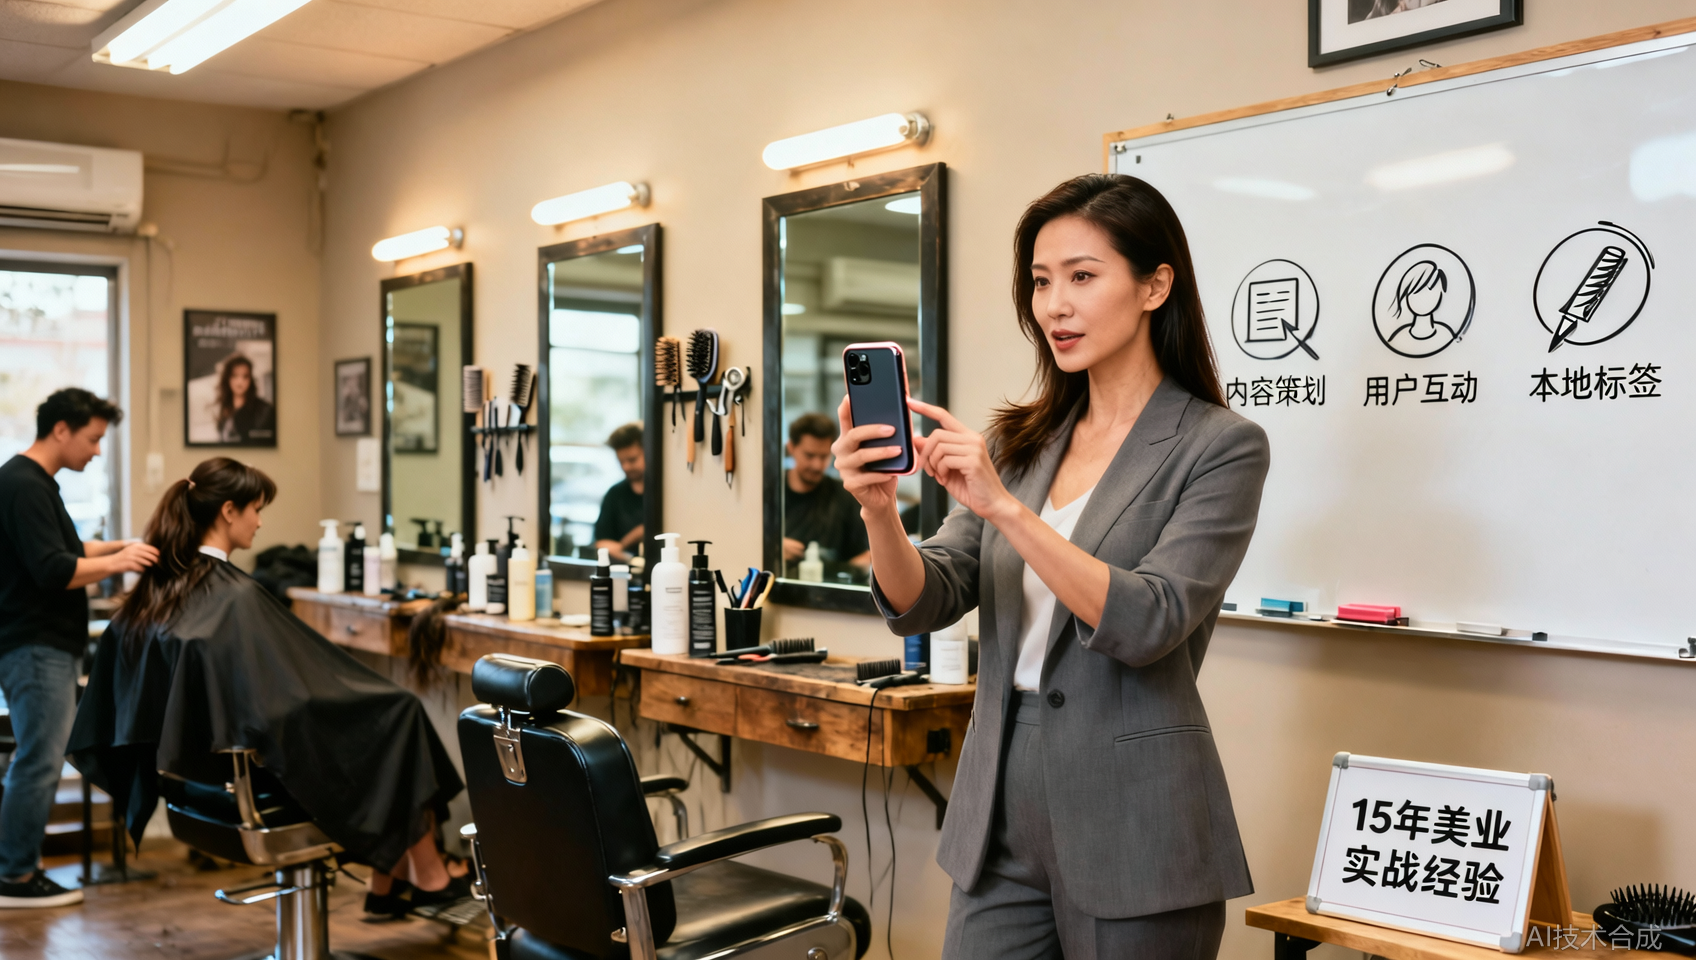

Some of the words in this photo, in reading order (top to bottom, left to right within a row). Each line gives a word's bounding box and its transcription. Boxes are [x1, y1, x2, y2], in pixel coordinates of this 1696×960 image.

[1226, 374, 1326, 409] 内容策划
[1363, 371, 1478, 407] 用户互动
[1529, 362, 1662, 402] 本地标签
[1352, 798, 1512, 852] 15年美业
[1342, 844, 1505, 904] 实战经验
